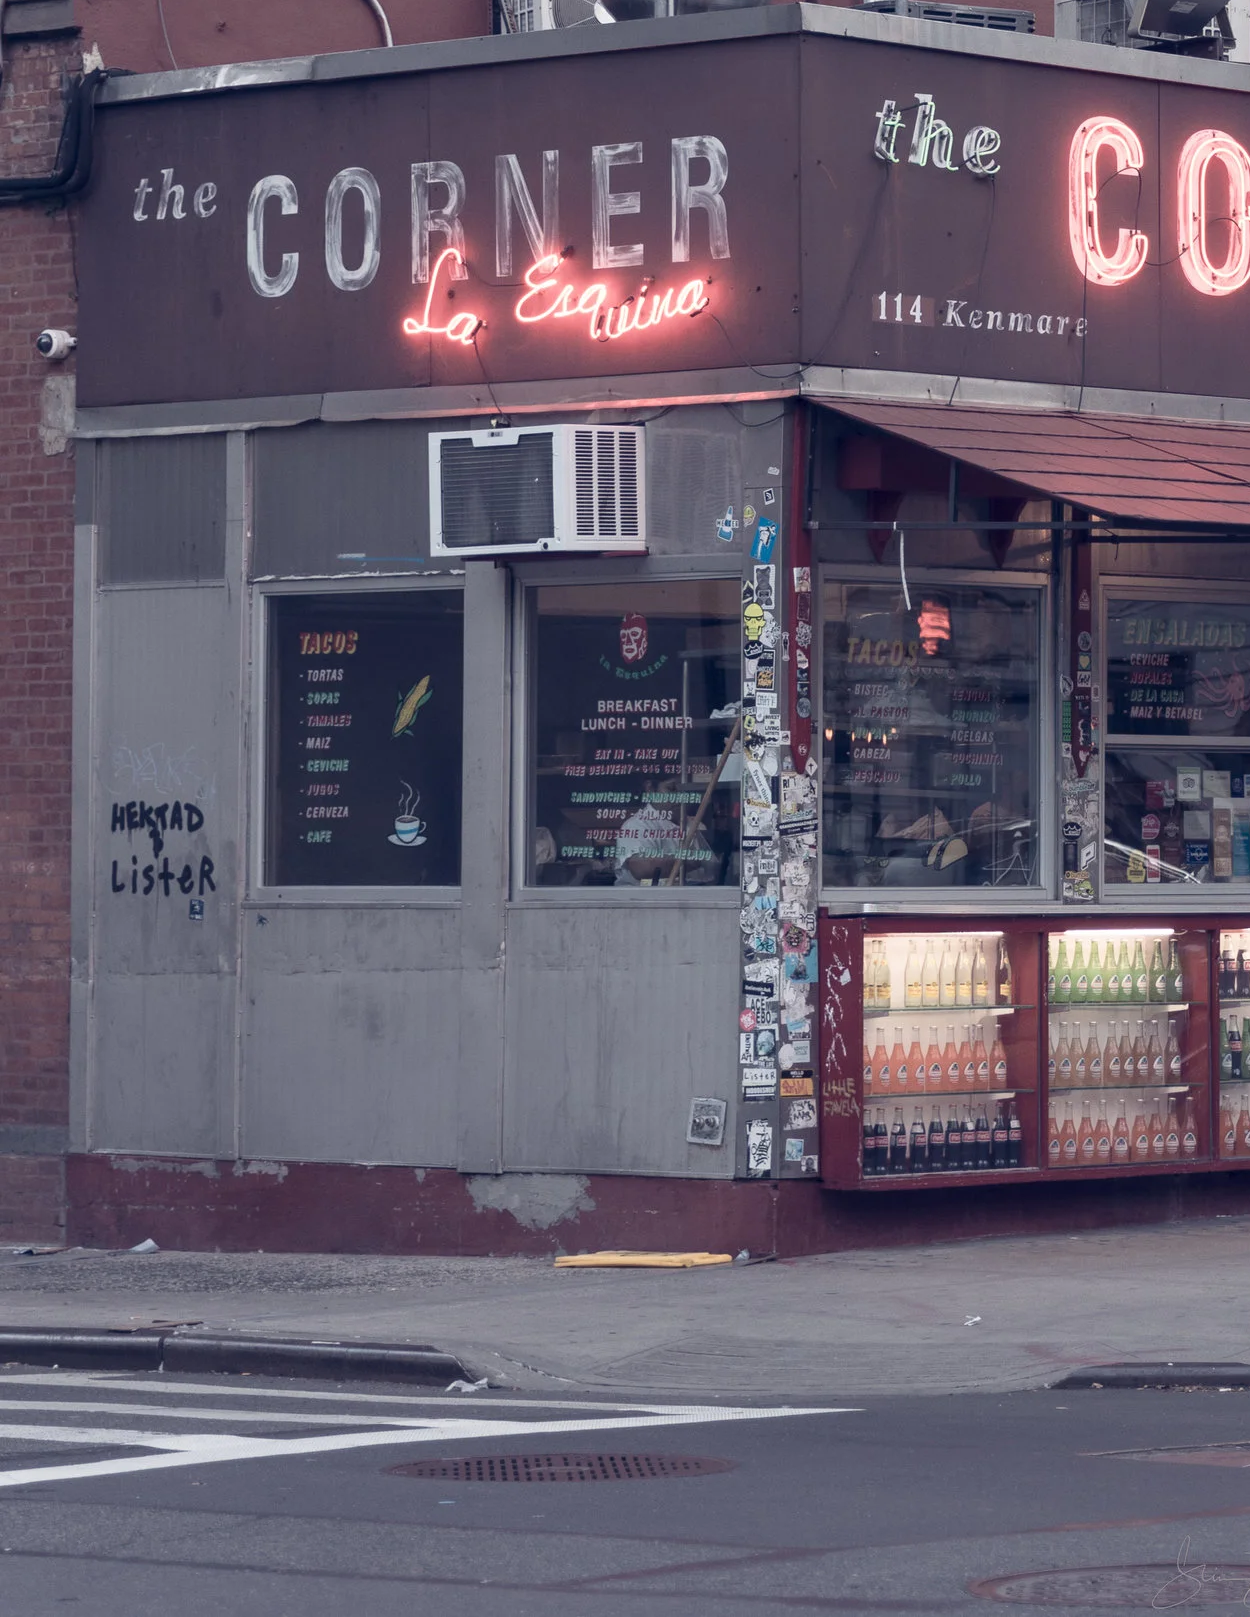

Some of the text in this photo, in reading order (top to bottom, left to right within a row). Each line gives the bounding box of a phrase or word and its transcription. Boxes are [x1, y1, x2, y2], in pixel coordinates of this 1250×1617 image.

[873, 93, 1001, 181] the
[133, 135, 731, 298] the CORNER
[403, 247, 711, 345] La Esquina
[876, 291, 1090, 338] 114 Kenmare
[1122, 618, 1247, 648] ENSALADAS
[299, 630, 359, 655] TACOS
[847, 637, 919, 667] TACOS
[1129, 653, 1170, 666] CEVICHE
[306, 669, 344, 682] TORTAS
[1129, 671, 1173, 685] NOPALES
[854, 683, 889, 697] BISTEC
[1130, 689, 1185, 703] DE LA CASA
[306, 692, 340, 706] SOPAS
[597, 698, 678, 713] BREAKFAST
[853, 706, 910, 720] AL PASTOR
[951, 709, 996, 723] CHORIZO
[1130, 705, 1205, 721] MAIZ Y BETABEL
[306, 714, 352, 728] TAMALES
[581, 716, 693, 731] LUNCH DINNER
[305, 736, 331, 750] MAIZ
[950, 729, 995, 743] ACELGAS
[594, 748, 680, 761] EAT IN TAKE OUT
[853, 747, 892, 761] CABEZA
[306, 759, 350, 773] CEVICHE
[564, 764, 585, 777] FREE
[588, 764, 634, 776] DELIVERY
[854, 769, 901, 783] PESCADO
[951, 773, 982, 787] POLLO
[306, 783, 340, 796] JUGOS
[570, 791, 633, 804] SANDWICHES
[305, 806, 349, 819] CERVEZA
[596, 808, 673, 821] SOUPS SALADS
[585, 828, 685, 840] ROTISSERIE CHICKEN
[560, 845, 595, 858] COFFEE
[603, 845, 626, 858] BEER
